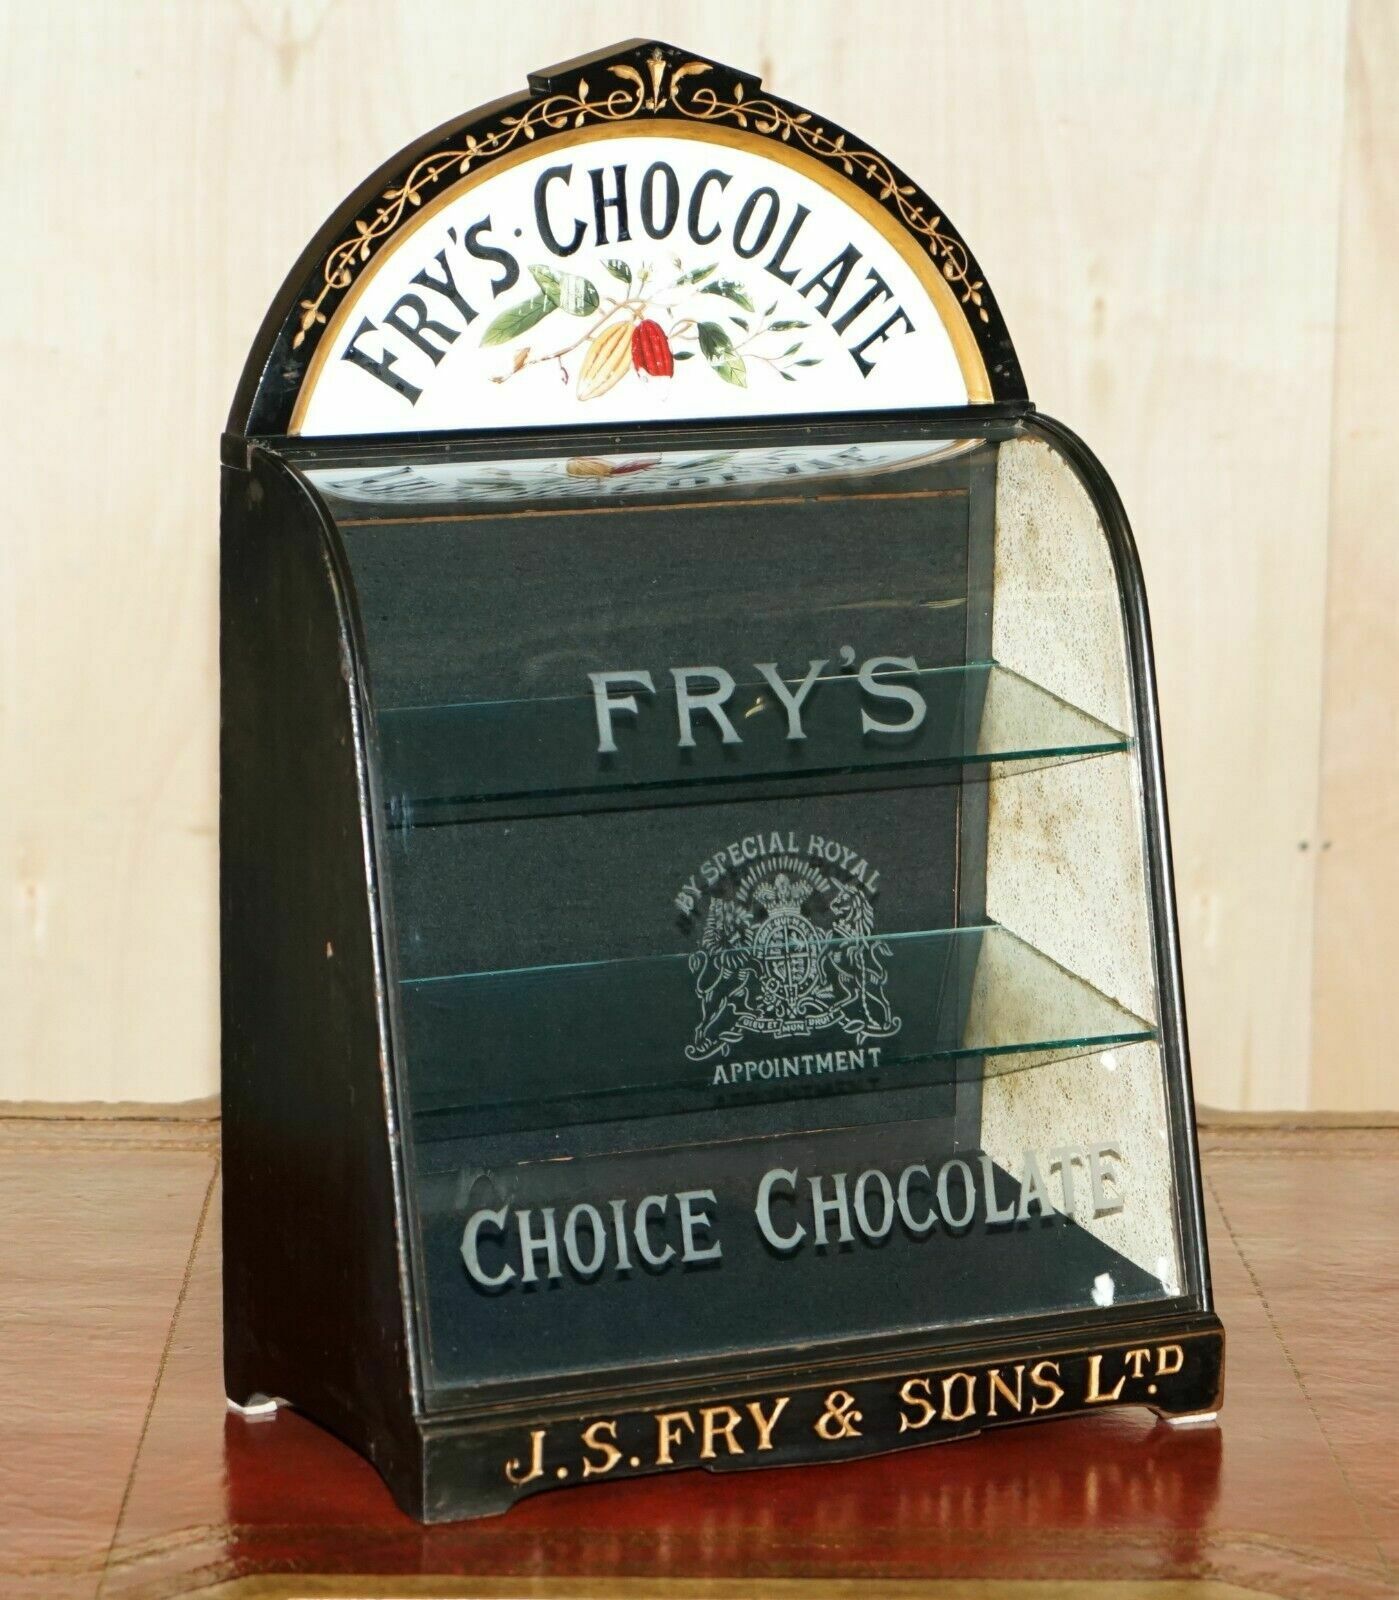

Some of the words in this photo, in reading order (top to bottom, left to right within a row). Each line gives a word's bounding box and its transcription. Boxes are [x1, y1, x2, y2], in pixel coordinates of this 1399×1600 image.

[340, 214, 521, 407] FRY'S
[533, 161, 916, 379] CHOCOLATE
[587, 645, 927, 753] FRY'S
[675, 875, 702, 916] BY
[701, 831, 800, 886] SPECIAL
[807, 834, 881, 894] ROYAL
[712, 1047, 881, 1085] APPOINTMENT
[460, 1189, 723, 1287] CHOICE
[754, 1140, 1125, 1250] CHOCOLATE
[814, 1390, 863, 1440] &
[899, 1361, 1065, 1433] SONS
